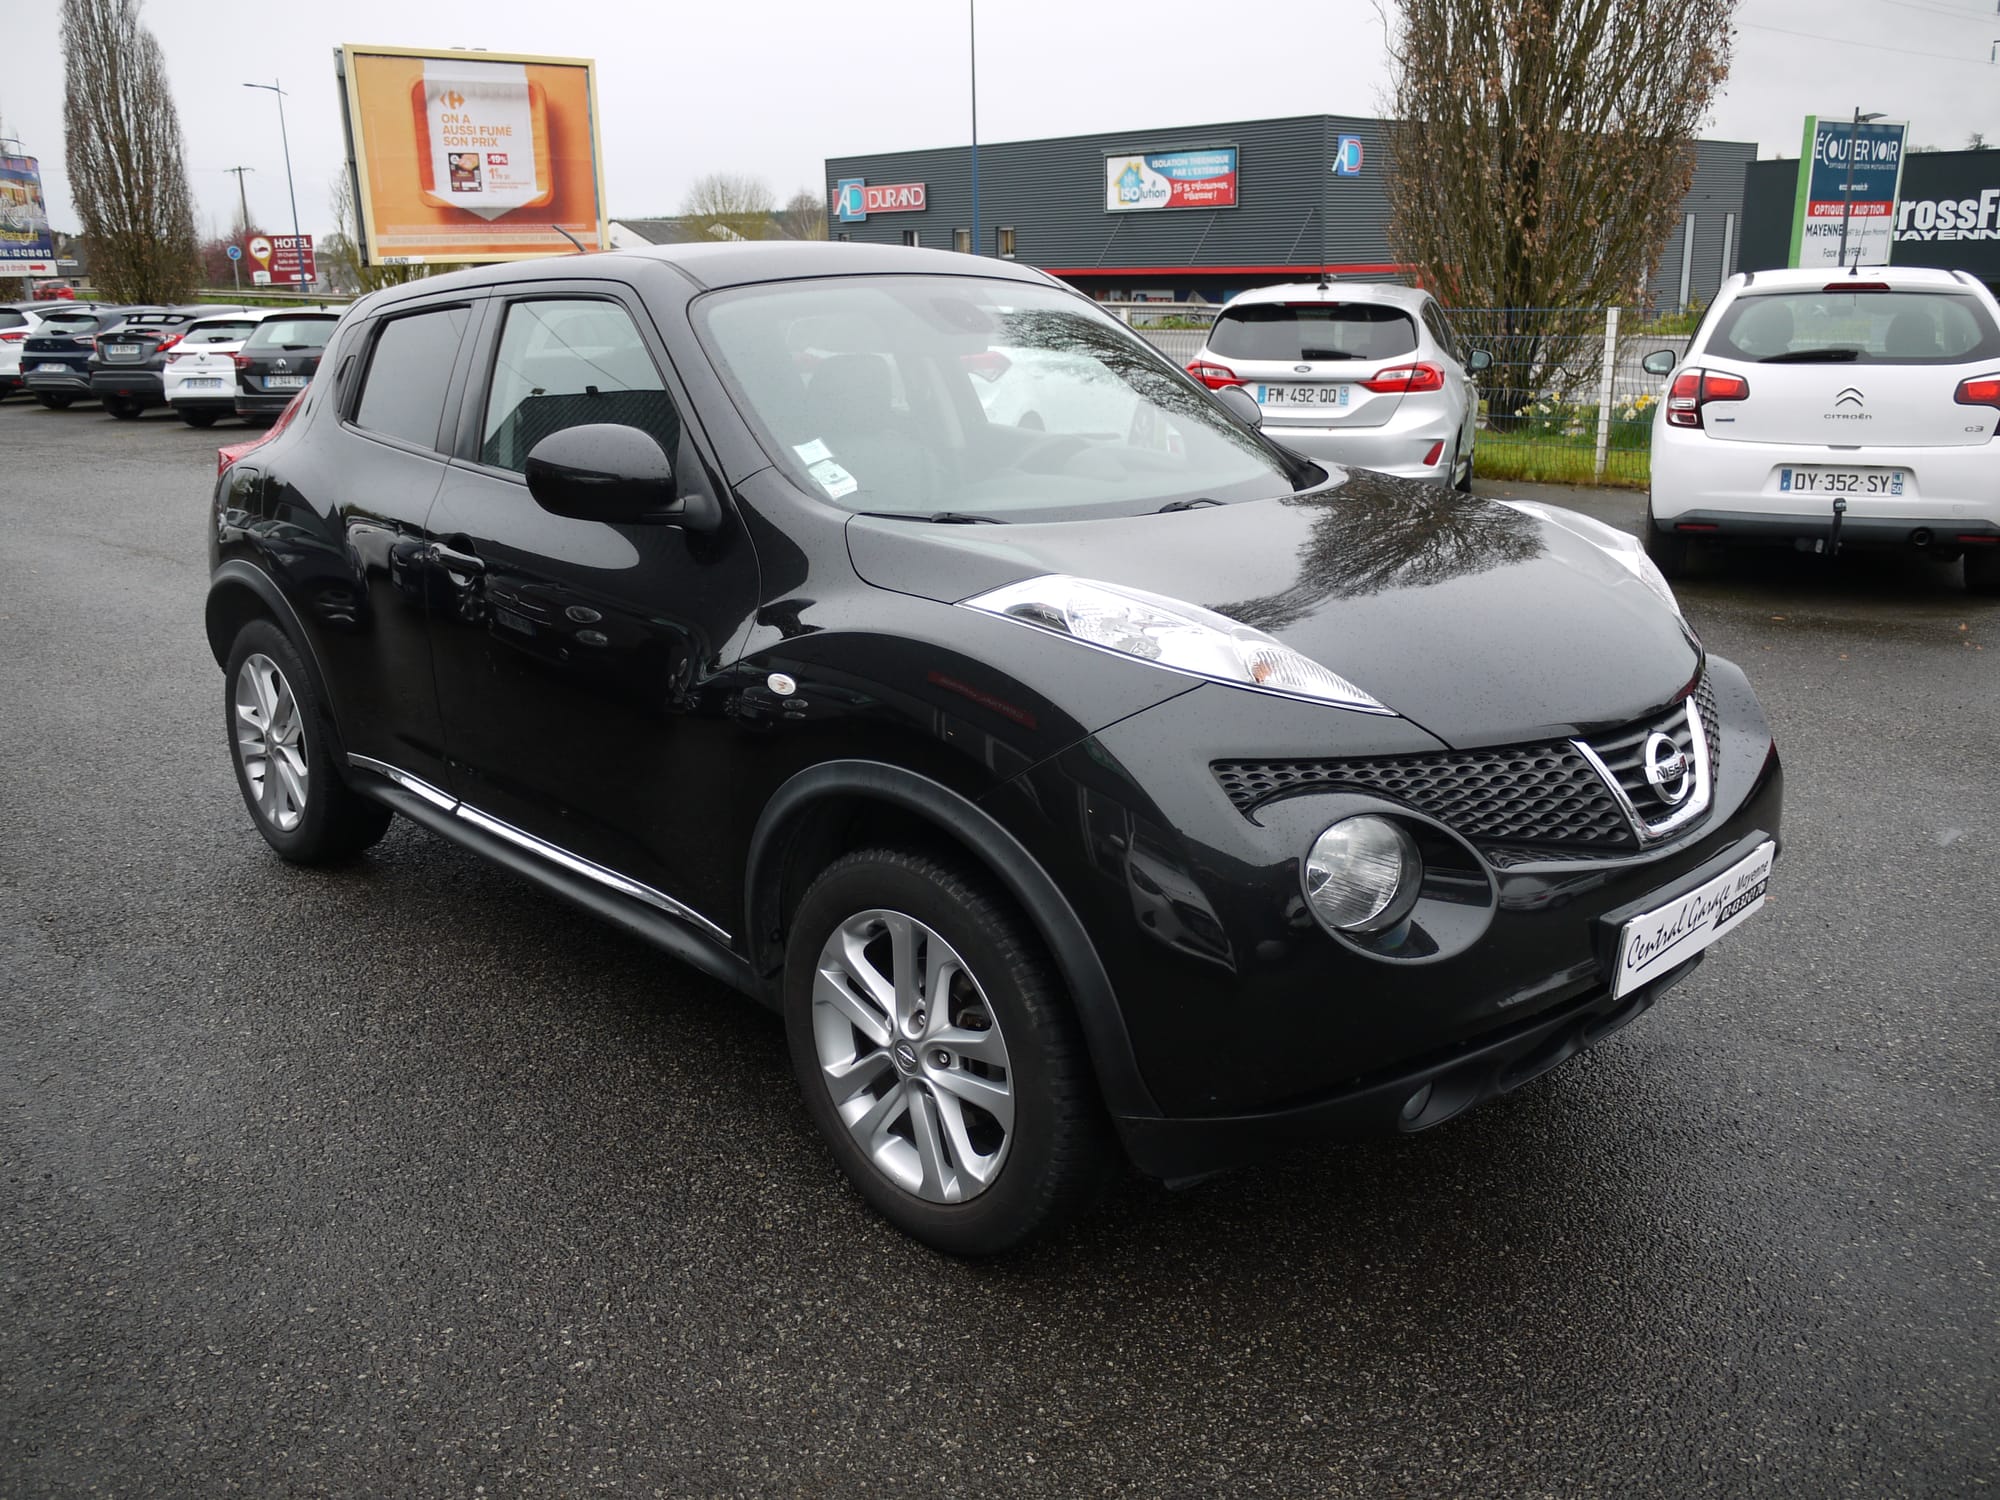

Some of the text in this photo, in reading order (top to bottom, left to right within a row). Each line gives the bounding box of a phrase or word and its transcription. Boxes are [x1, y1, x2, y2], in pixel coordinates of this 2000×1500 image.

[441, 113, 471, 123] ON A
[443, 125, 477, 135] AUSSI
[444, 137, 499, 147] SON PRIX
[1815, 132, 1899, 165] ÉCOUTER VOIR
[1332, 139, 1364, 172] AD
[833, 184, 924, 215] AD DURAND
[1814, 204, 1844, 215] OPTIQUE
[1896, 189, 2000, 230] rossF
[1806, 223, 1844, 237] MAYENNE
[1893, 229, 2000, 242] AYENN
[274, 237, 311, 249] HOTEL
[1823, 248, 1837, 258] Face
[1268, 387, 1337, 403] FM-492-QQ
[1964, 425, 1985, 433] C3
[1794, 472, 1890, 493] DY-352-SY
[1891, 485, 1902, 494] 50
[1627, 903, 1688, 968] Central
[1688, 884, 1731, 930] Garage
[1735, 860, 1769, 892] Mayenne
